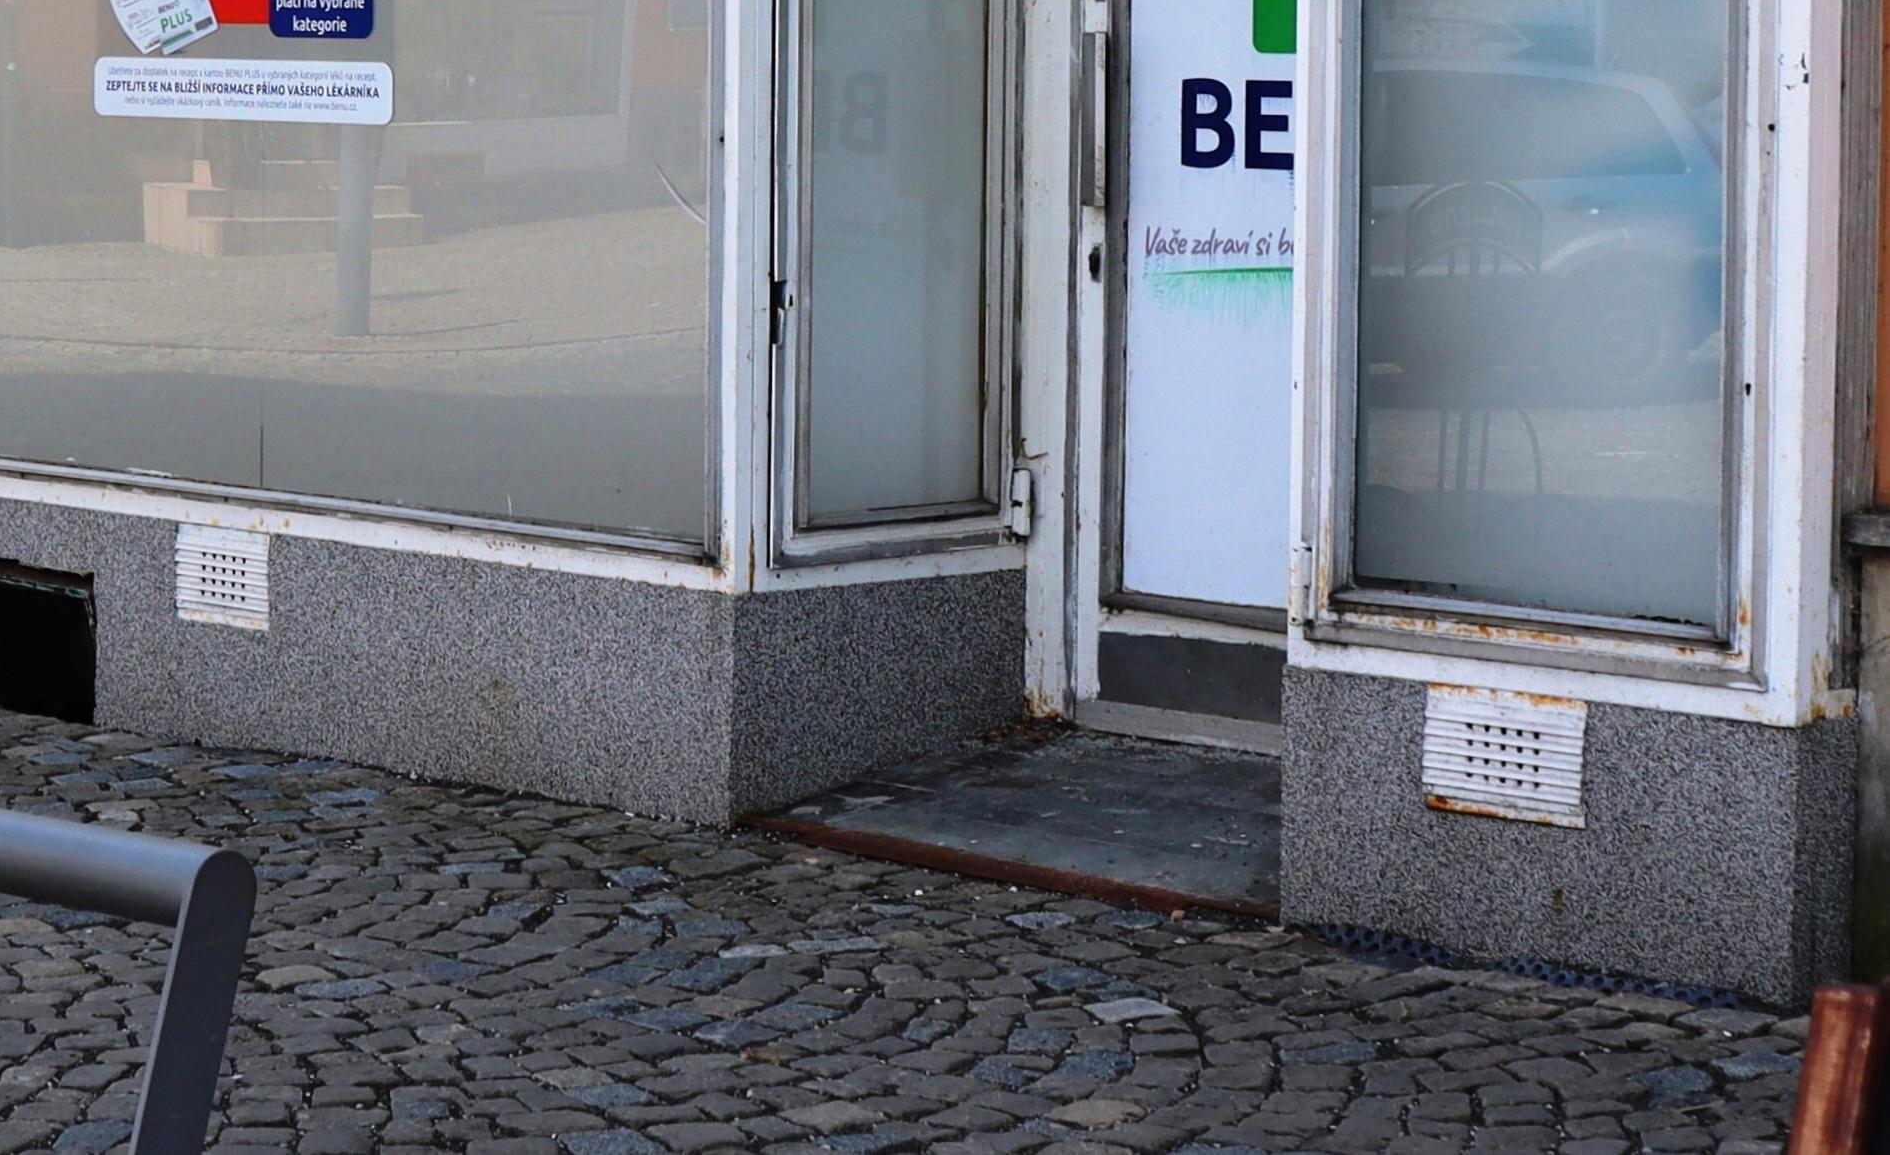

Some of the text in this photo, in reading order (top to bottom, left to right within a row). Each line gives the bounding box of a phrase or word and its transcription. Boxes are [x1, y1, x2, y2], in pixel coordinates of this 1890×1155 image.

[160, 9, 193, 33] PLUS
[293, 15, 348, 35] kategorie
[106, 79, 380, 98] ZEPTEJTE SE NA BLIŽŠÍ INFORMACE PŘÍMO VAŠEHO LÉKÁRNÍKA
[1145, 226, 1187, 258] Vaše
[1191, 228, 1254, 256] zdraví
[1256, 232, 1272, 256] si
